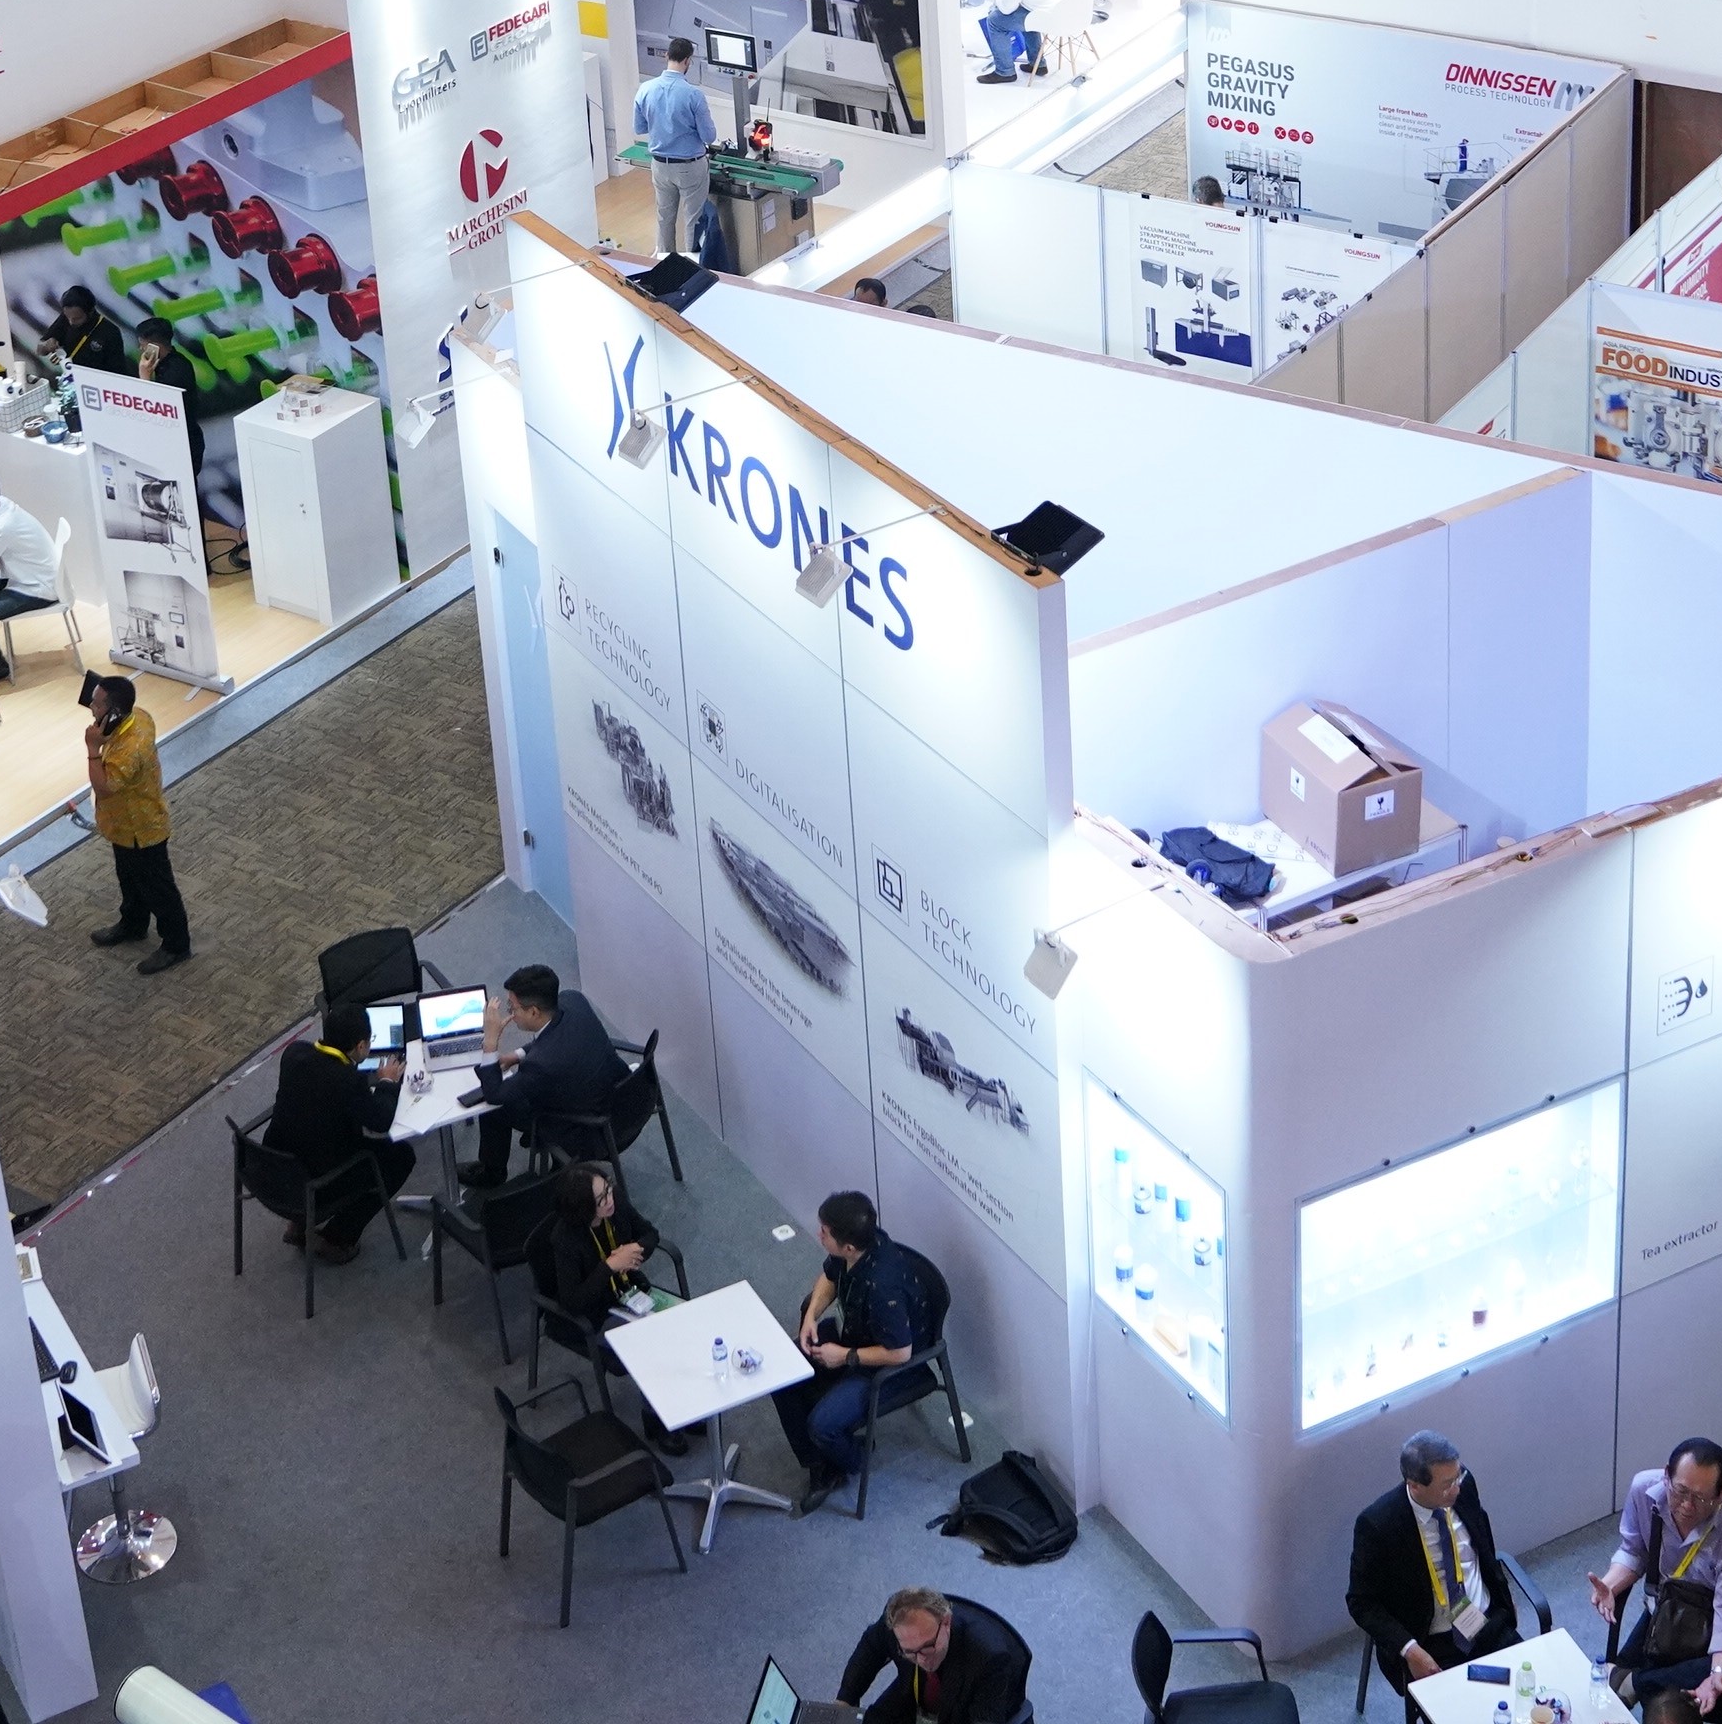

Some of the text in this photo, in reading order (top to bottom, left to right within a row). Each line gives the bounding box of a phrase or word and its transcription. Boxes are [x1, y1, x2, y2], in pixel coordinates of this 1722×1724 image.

[488, 1, 550, 42] FEDEGARI
[392, 48, 457, 98] GEA
[1206, 53, 1295, 82] PEGASUS
[1445, 63, 1557, 98] DINNISSEN
[1206, 72, 1289, 100] GRAVITY
[1445, 83, 1552, 108] PROCESS TECHNOLOGY
[1206, 91, 1276, 117] MIXING
[1378, 105, 1428, 118] Large front hatch
[447, 189, 527, 244] MARCHESINI
[1205, 221, 1241, 232] YOUNGSUN
[1139, 225, 1191, 239] VACUUM MACHINE
[1140, 237, 1214, 256] PALLET STRETCH WRAPPER
[1171, 236, 1197, 246] MACHINE
[1140, 244, 1185, 258] CARTON SEALER
[1344, 248, 1381, 260] YOUNGSUN
[1602, 347, 1669, 376] FOOD
[1603, 340, 1644, 354] ASIA PACIFIC
[104, 389, 179, 420] FEDEGARI
[664, 391, 914, 651] KRONES
[585, 598, 652, 670] RECYCLING
[587, 626, 671, 712] TECHNOLOGY
[735, 758, 843, 868] DIGITALISATION
[920, 889, 974, 952] BLOCK
[921, 921, 1036, 1035] TECHNOLOGY
[1641, 1220, 1720, 1262] Tea extractor
